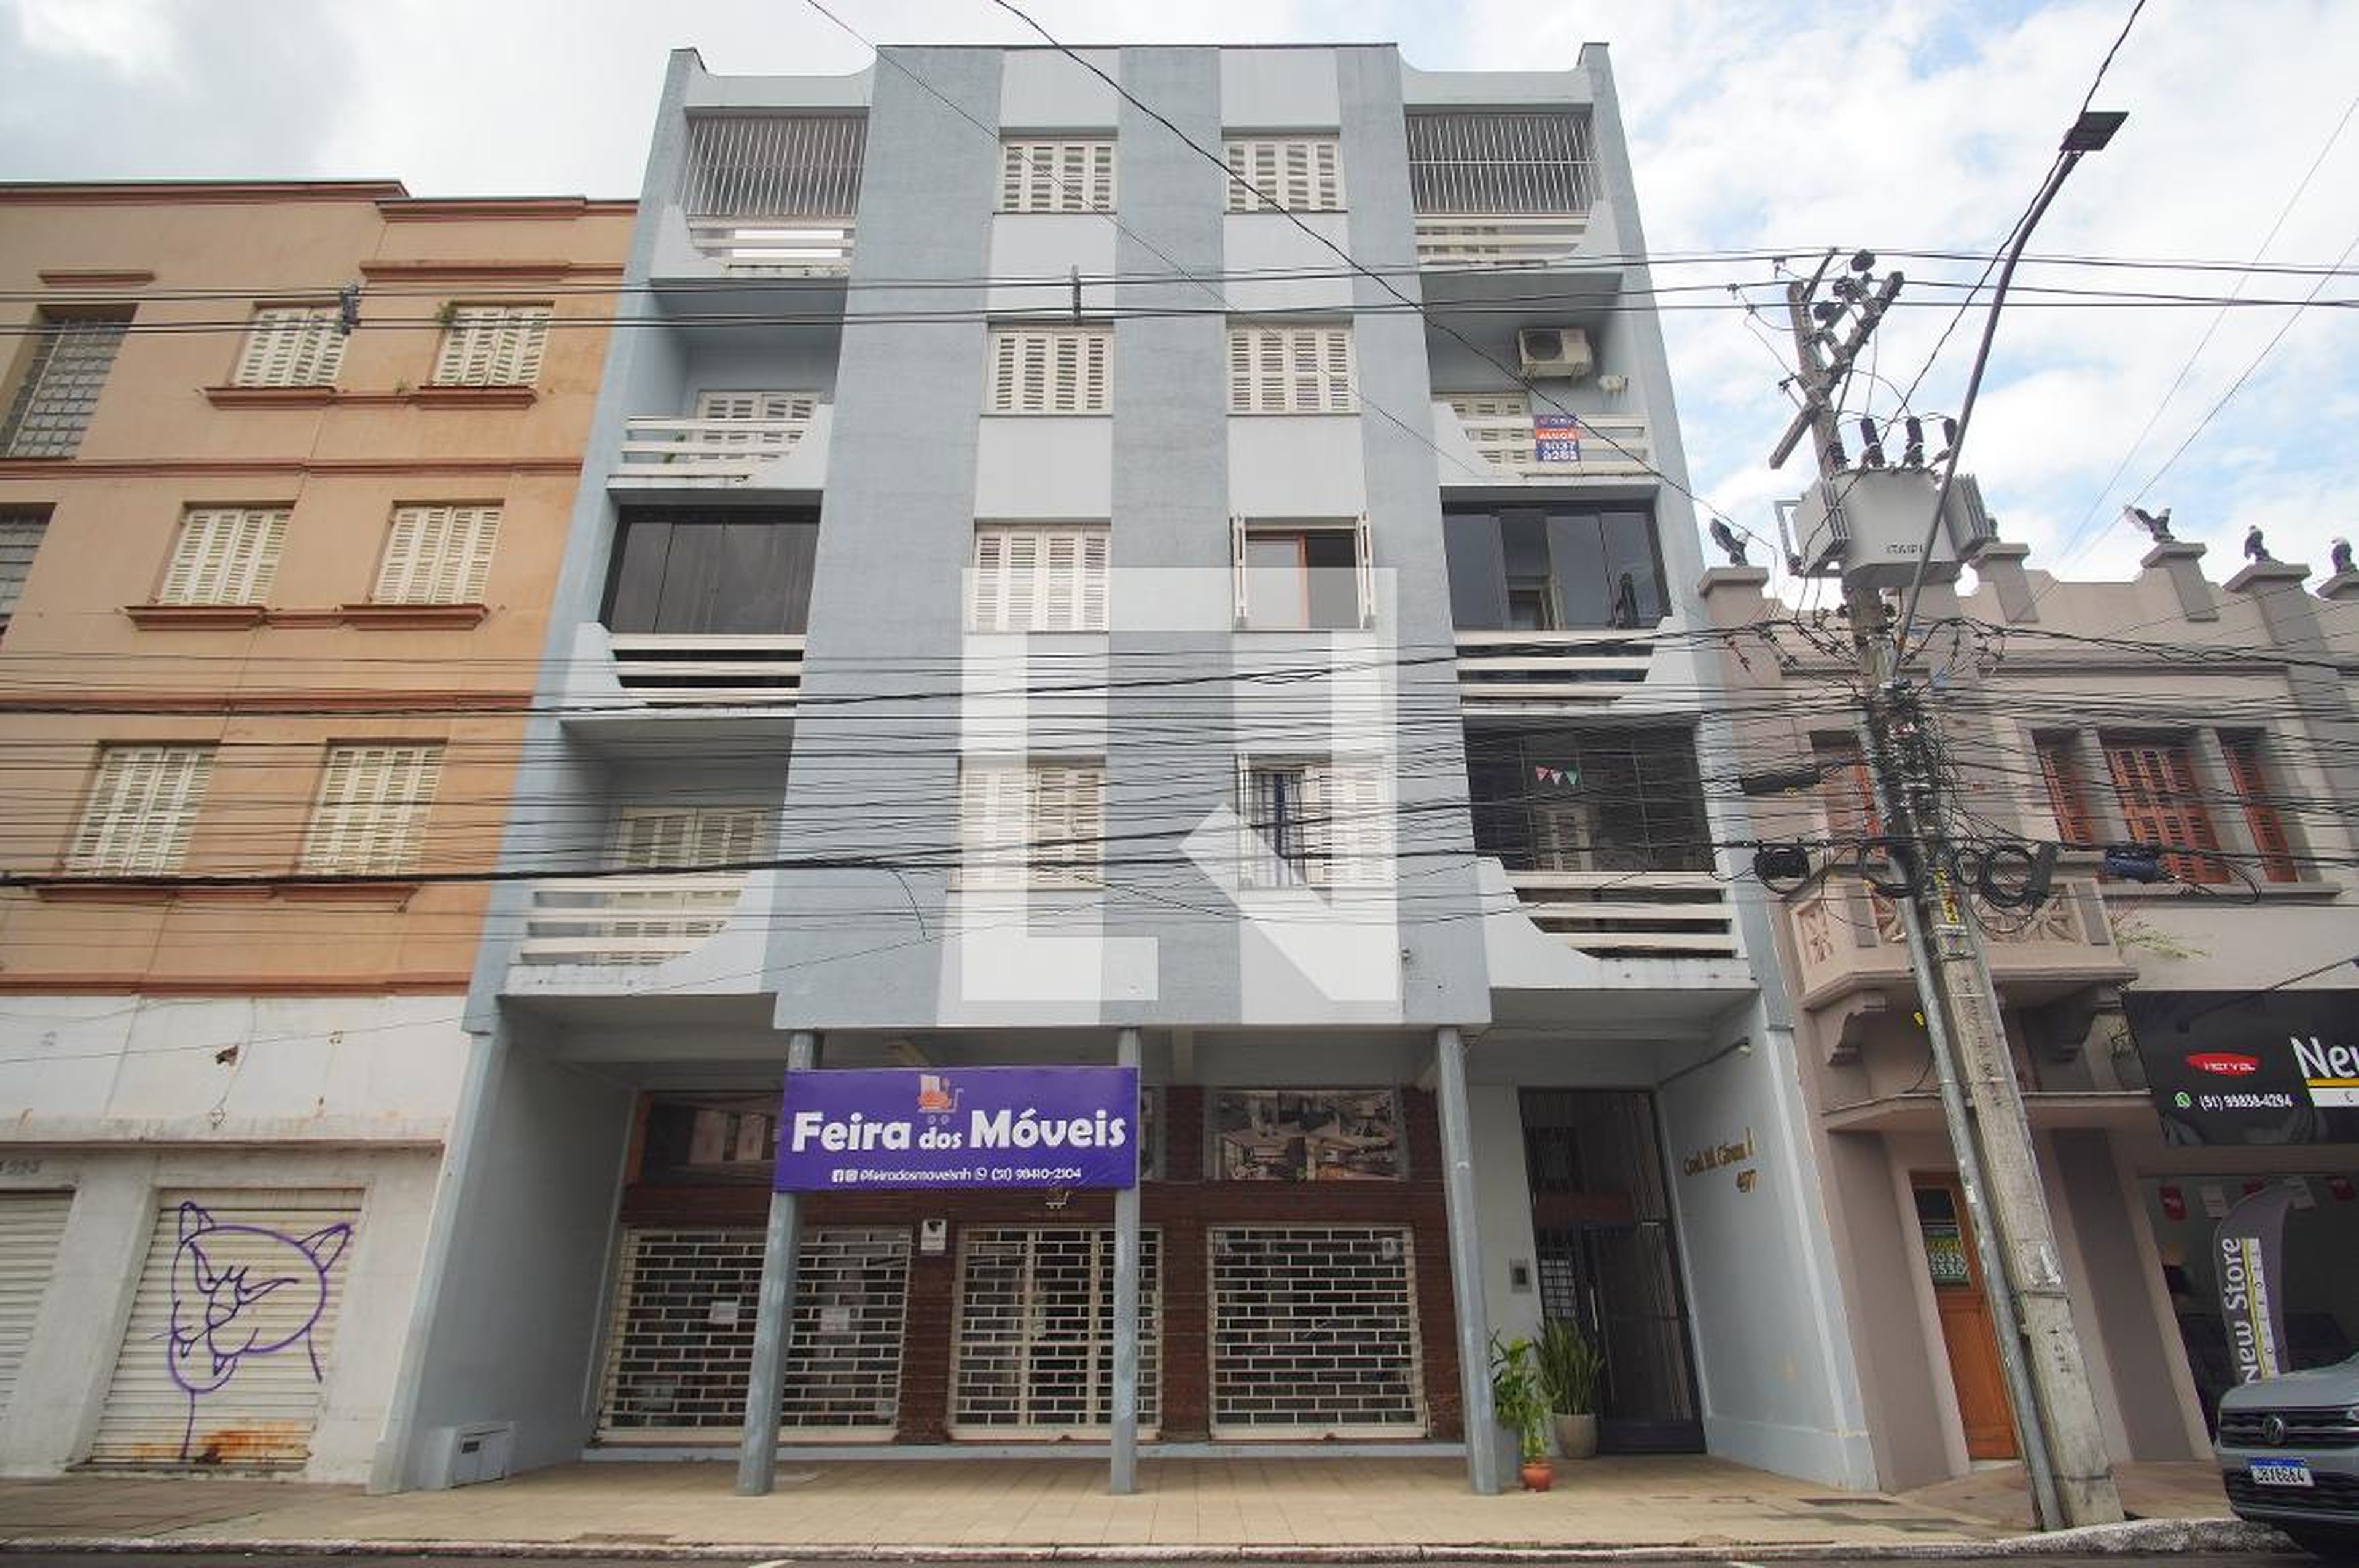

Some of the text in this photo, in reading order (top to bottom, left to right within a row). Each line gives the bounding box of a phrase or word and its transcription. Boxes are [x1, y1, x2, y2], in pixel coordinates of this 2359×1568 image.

[792, 1107, 1126, 1152] Feira dos Móveis
[2221, 1238, 2261, 1383] New Store
